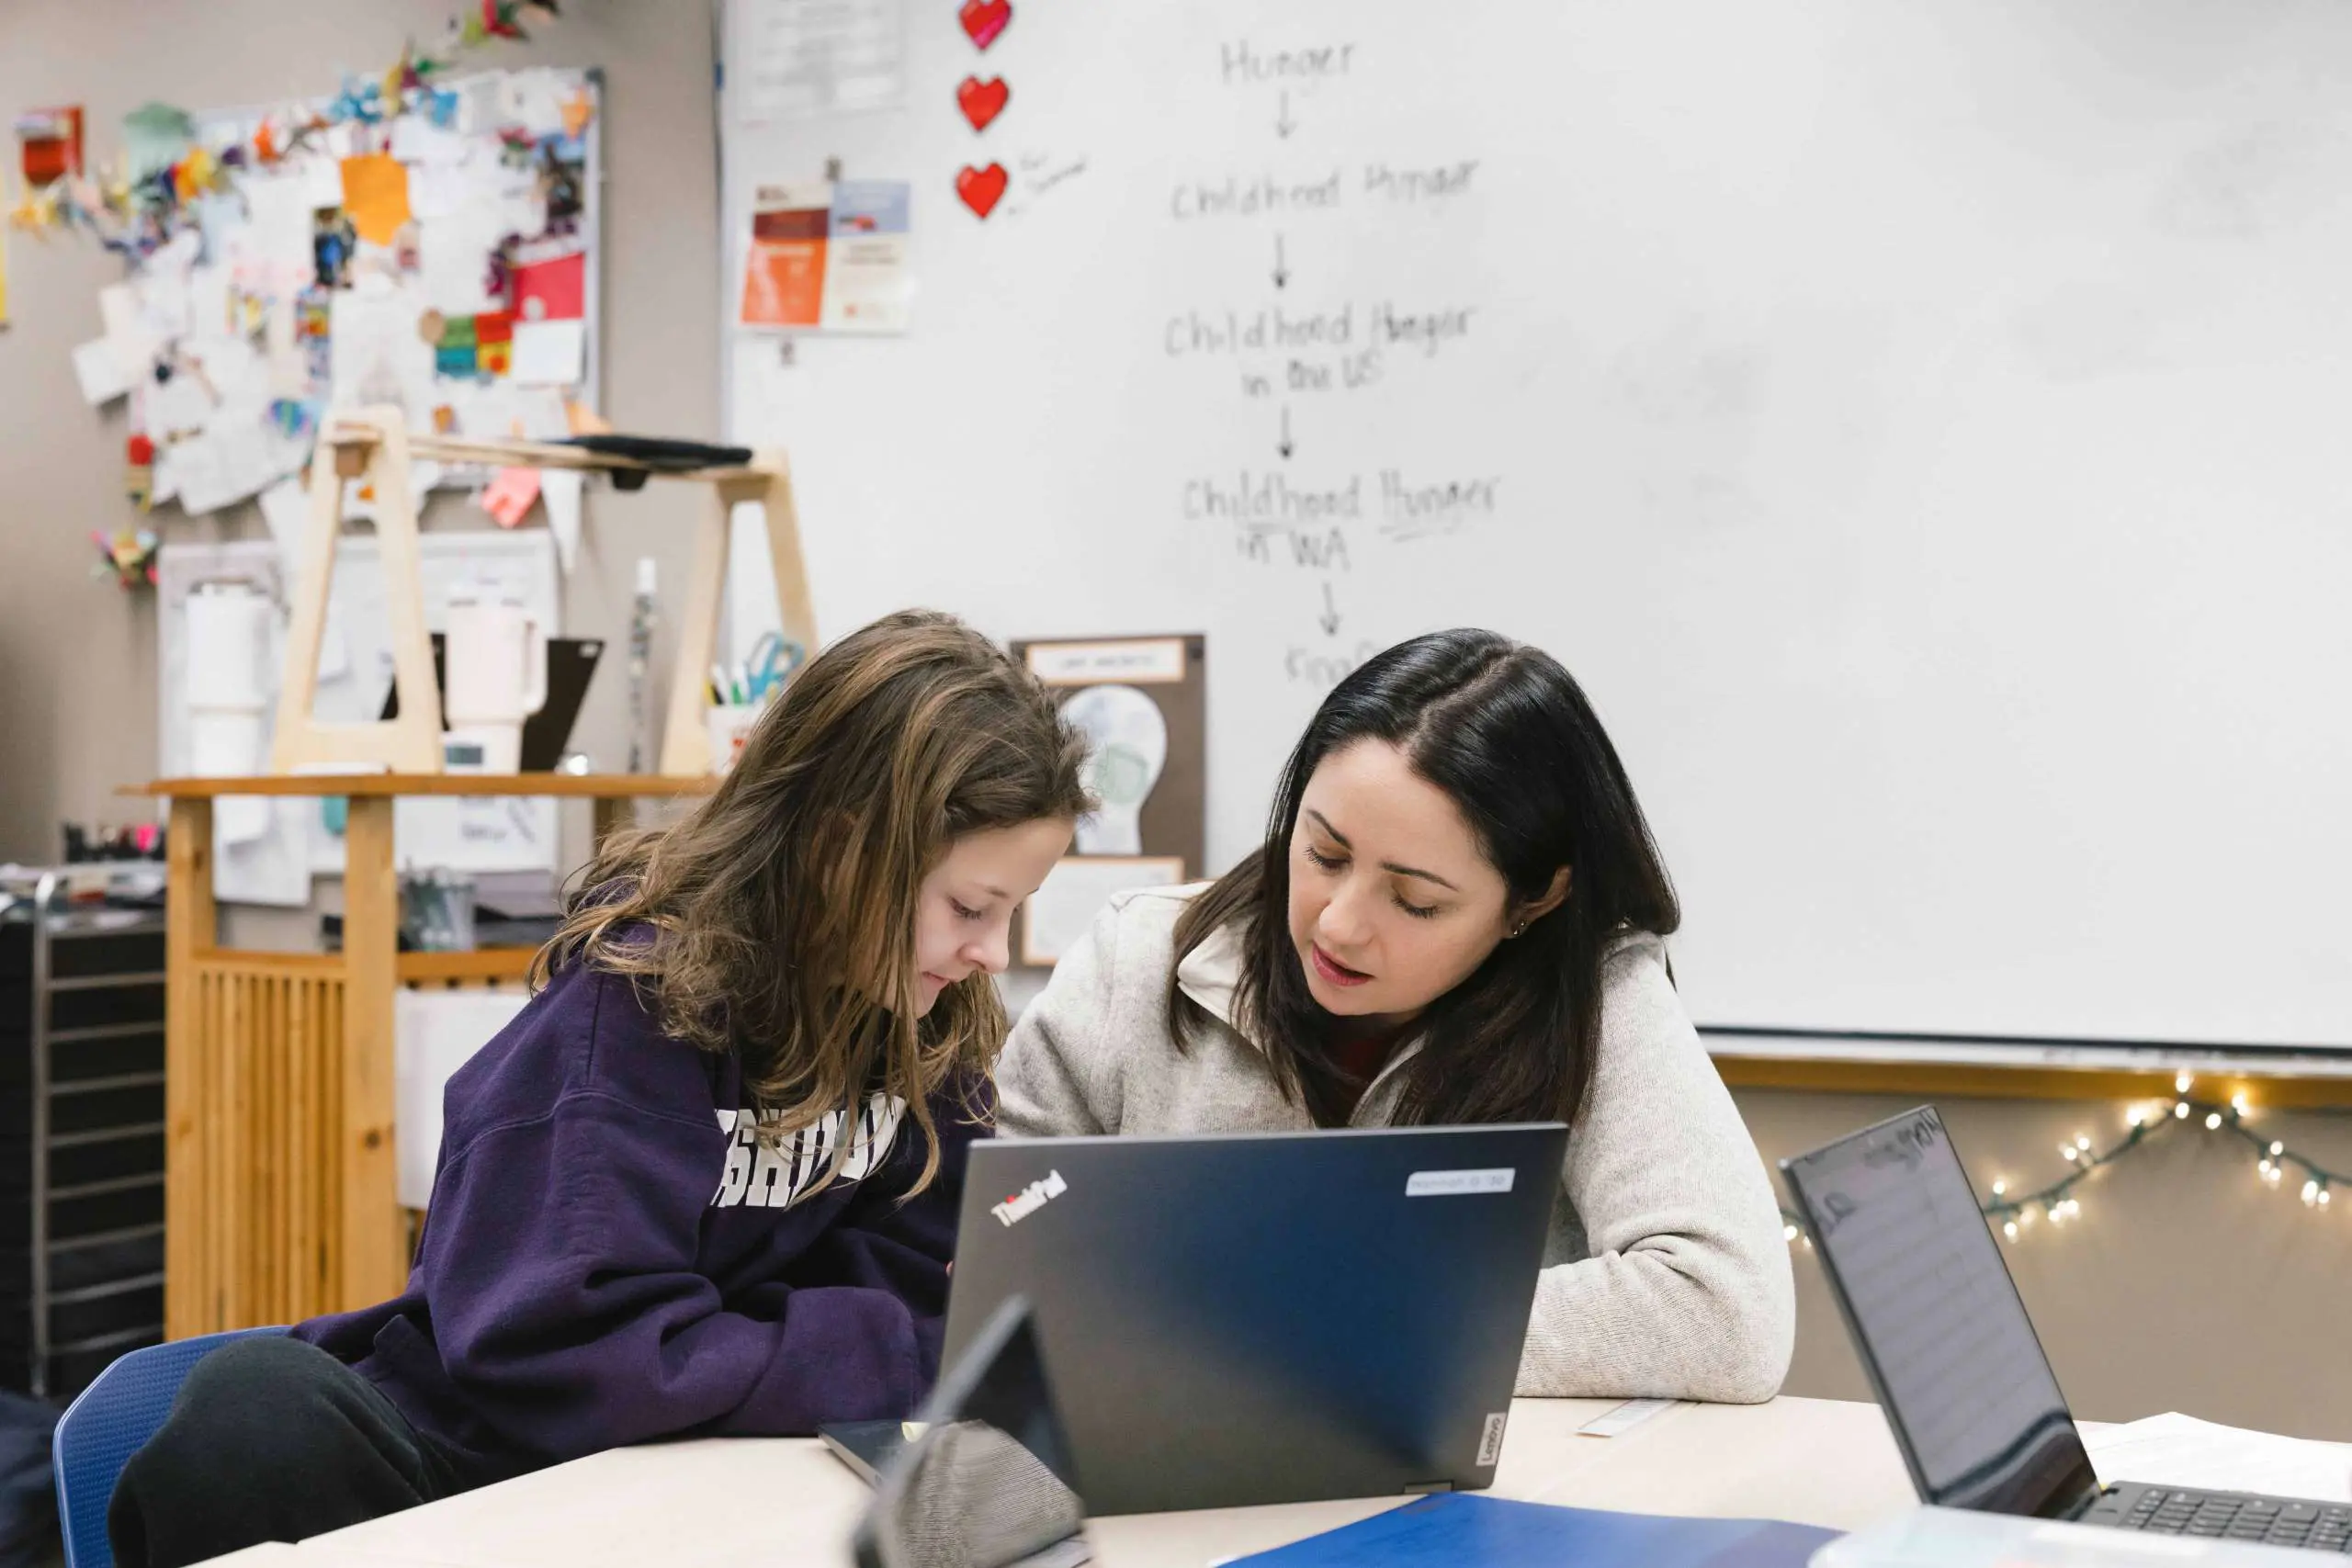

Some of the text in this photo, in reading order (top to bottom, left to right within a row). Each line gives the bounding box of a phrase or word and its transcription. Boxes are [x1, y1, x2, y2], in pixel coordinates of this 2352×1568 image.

[1220, 39, 1356, 91] Hunger
[1170, 164, 1341, 220] Childhood
[1164, 299, 1353, 357] Childhood
[1182, 468, 1507, 525] Childhood Hunger
[1288, 526, 1351, 572] WA
[1482, 1417, 1500, 1462] Lenovo
